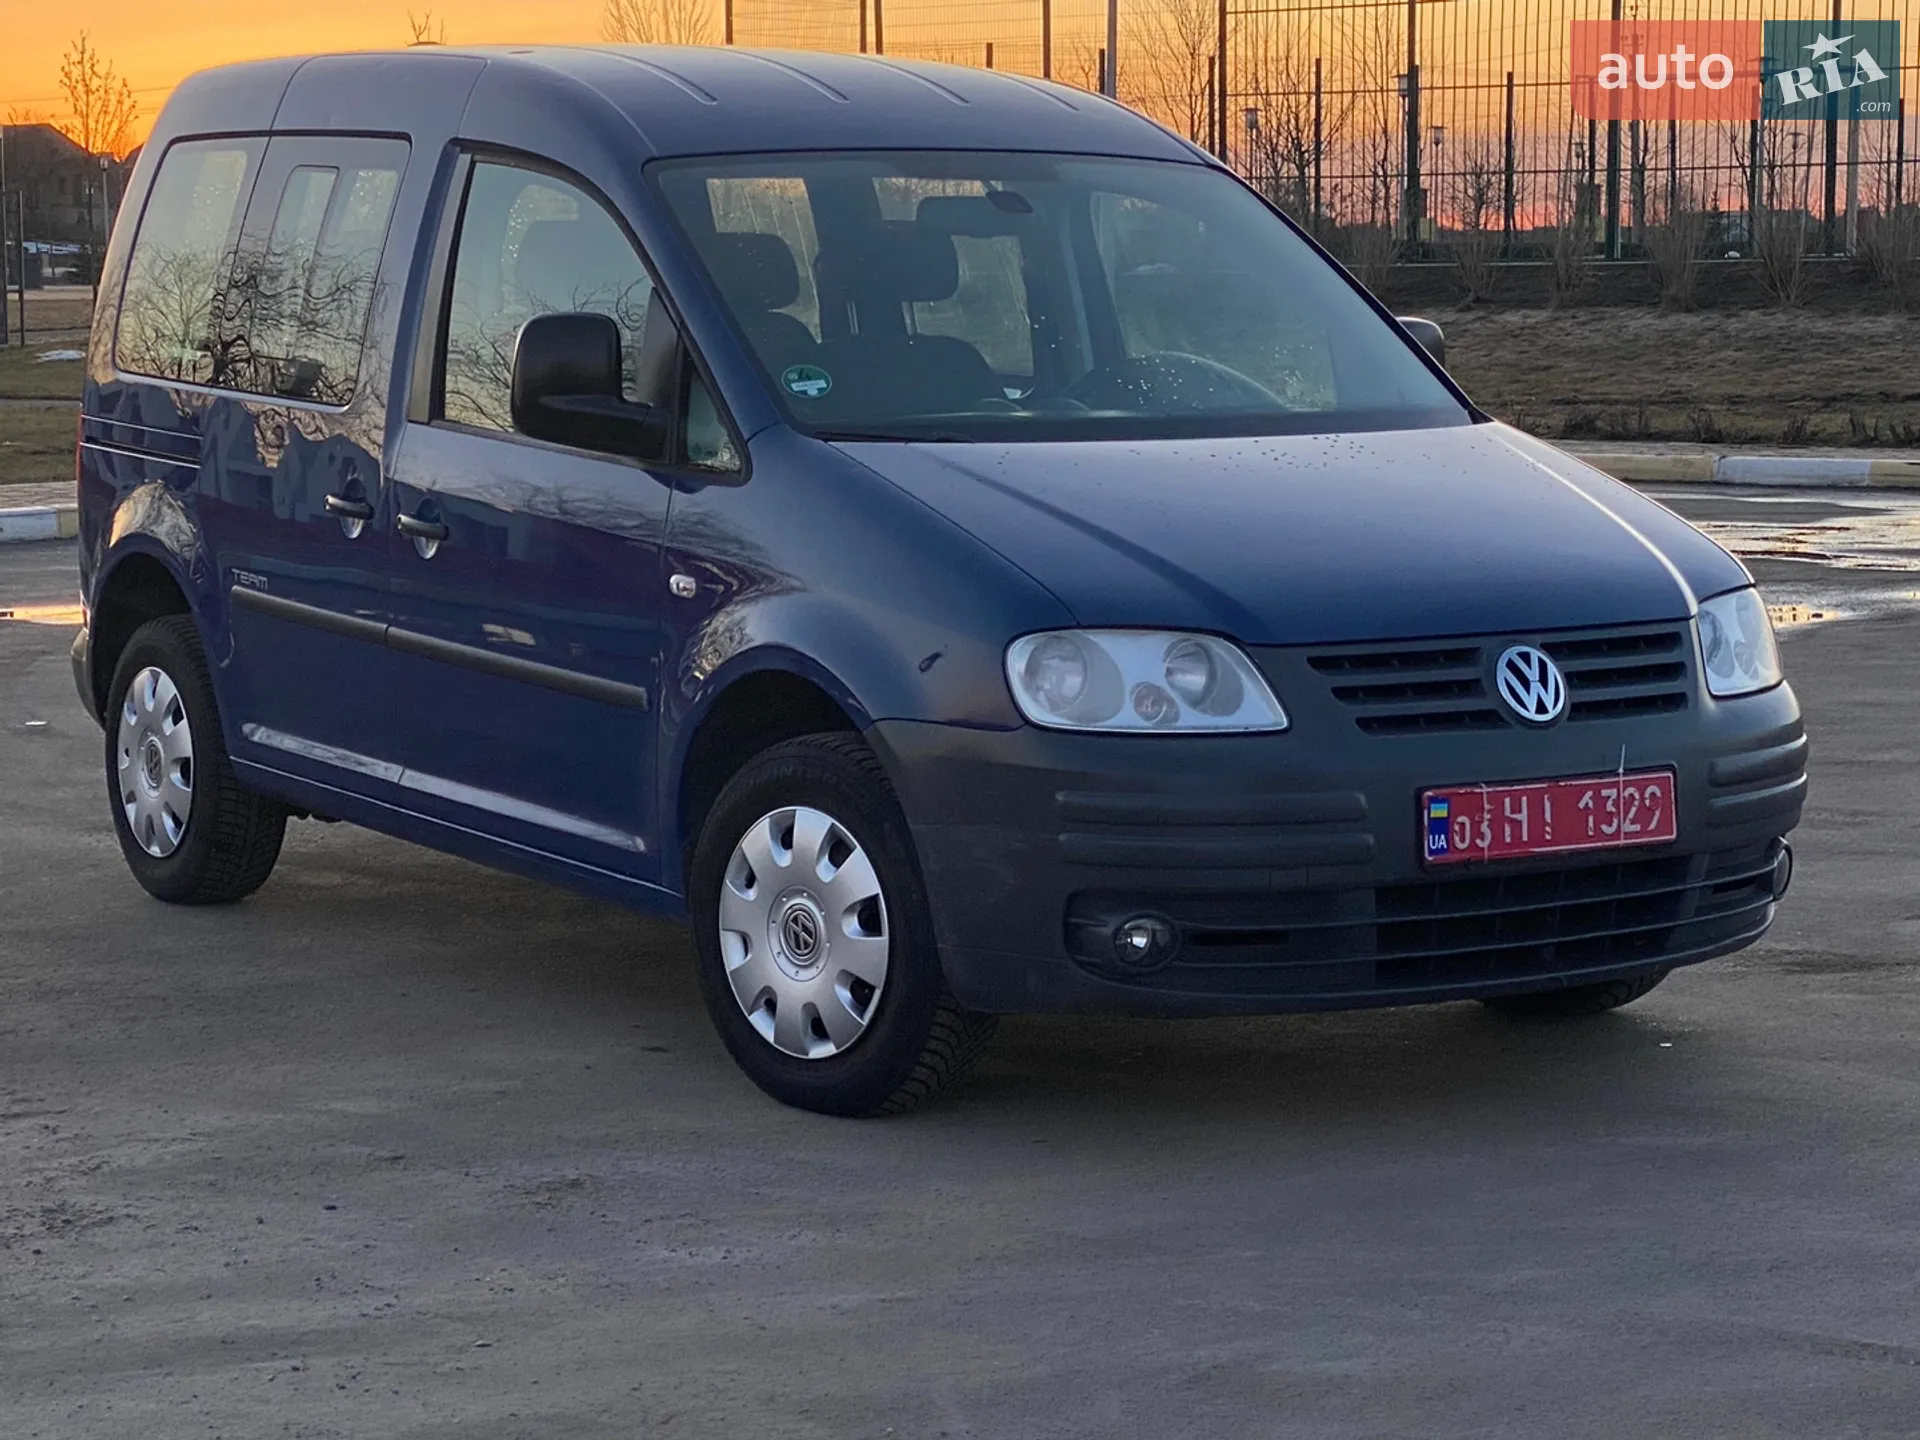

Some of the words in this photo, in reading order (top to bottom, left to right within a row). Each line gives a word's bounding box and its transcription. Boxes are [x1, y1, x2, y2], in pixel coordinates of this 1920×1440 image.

[231, 568, 268, 591] TEAM
[1578, 785, 1661, 836] 1329
[1429, 834, 1447, 849] UA
